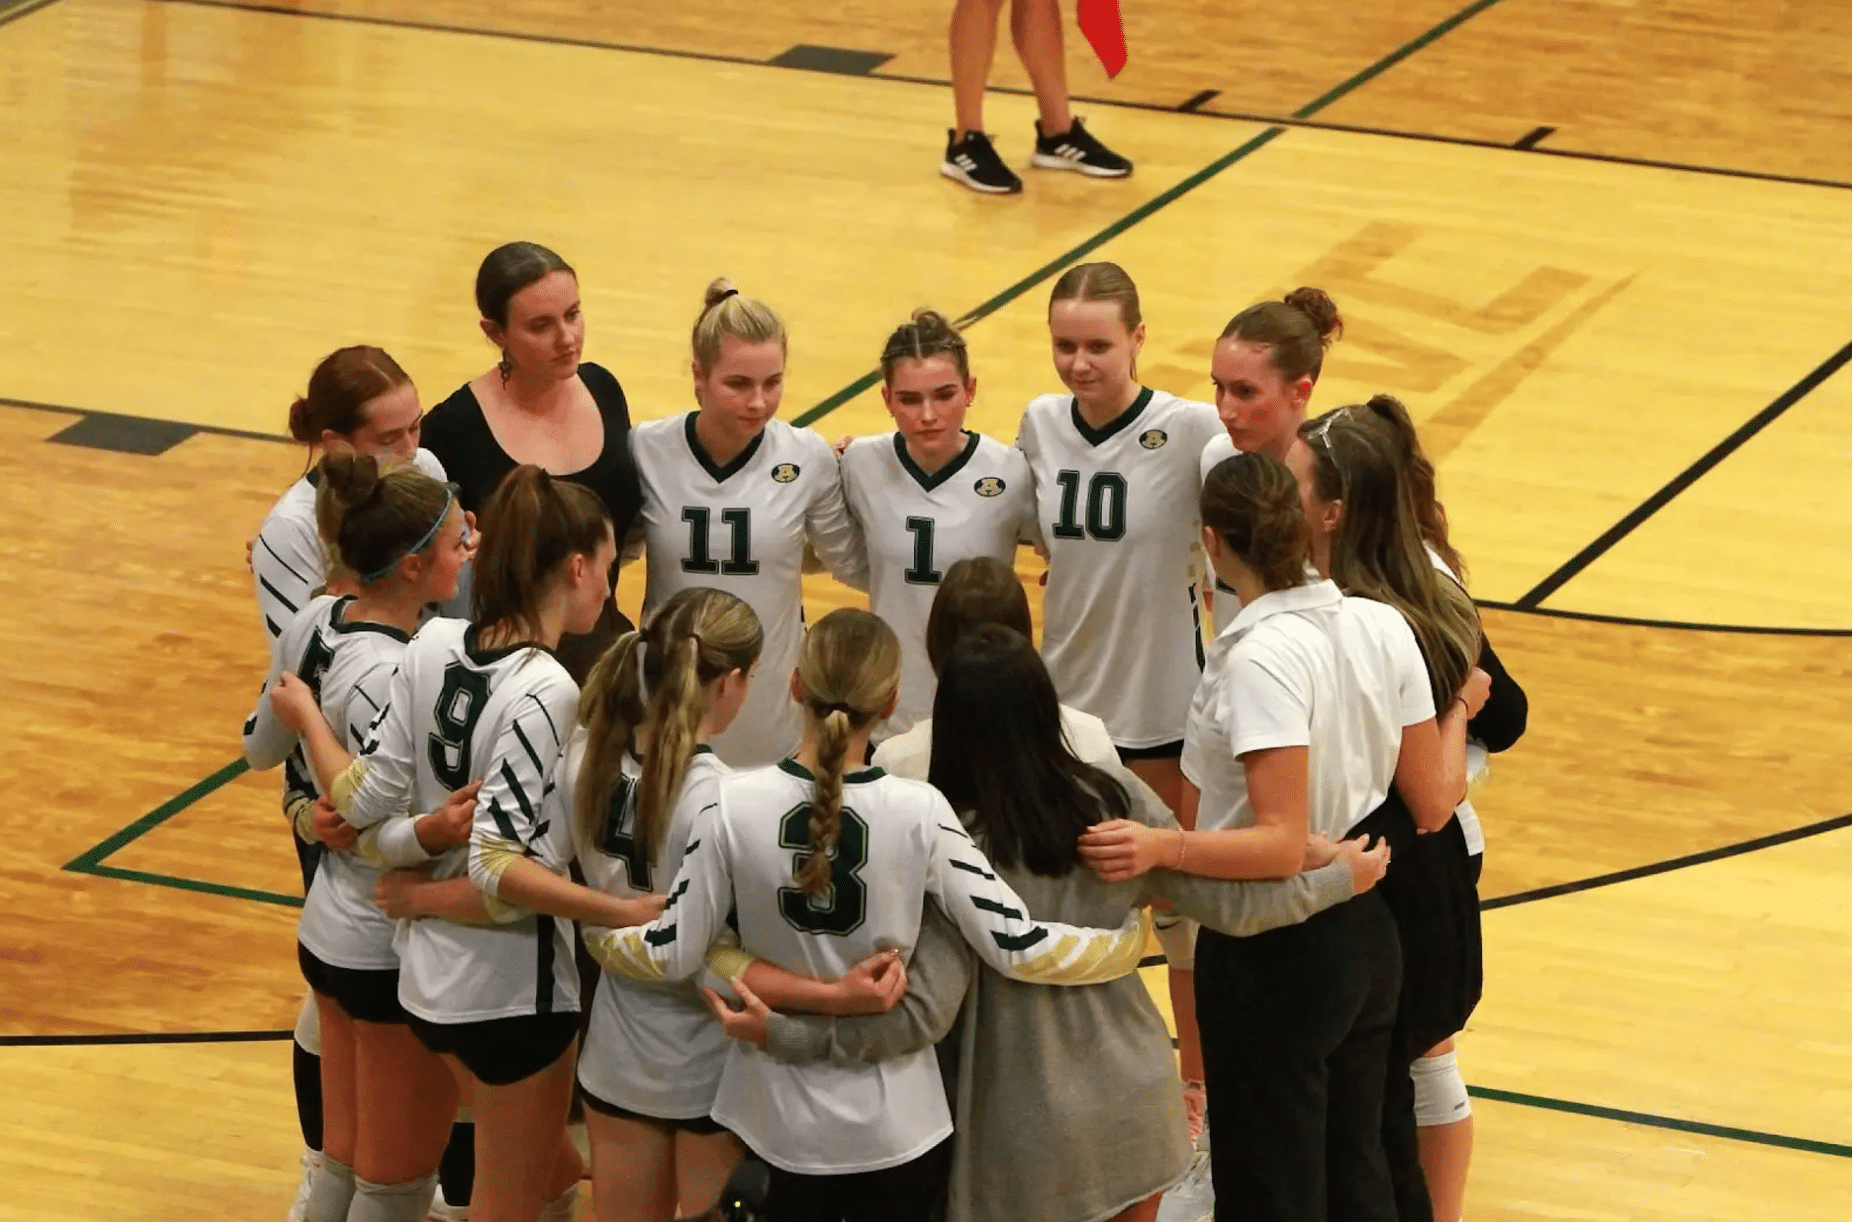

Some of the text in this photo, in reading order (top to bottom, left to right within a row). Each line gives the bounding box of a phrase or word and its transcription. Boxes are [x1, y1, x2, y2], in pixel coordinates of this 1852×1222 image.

[681, 506, 760, 576] 11
[904, 515, 942, 585] 1
[1051, 469, 1128, 542] 10
[427, 660, 492, 792] 9
[593, 772, 655, 893] 4
[777, 801, 869, 937] 3
